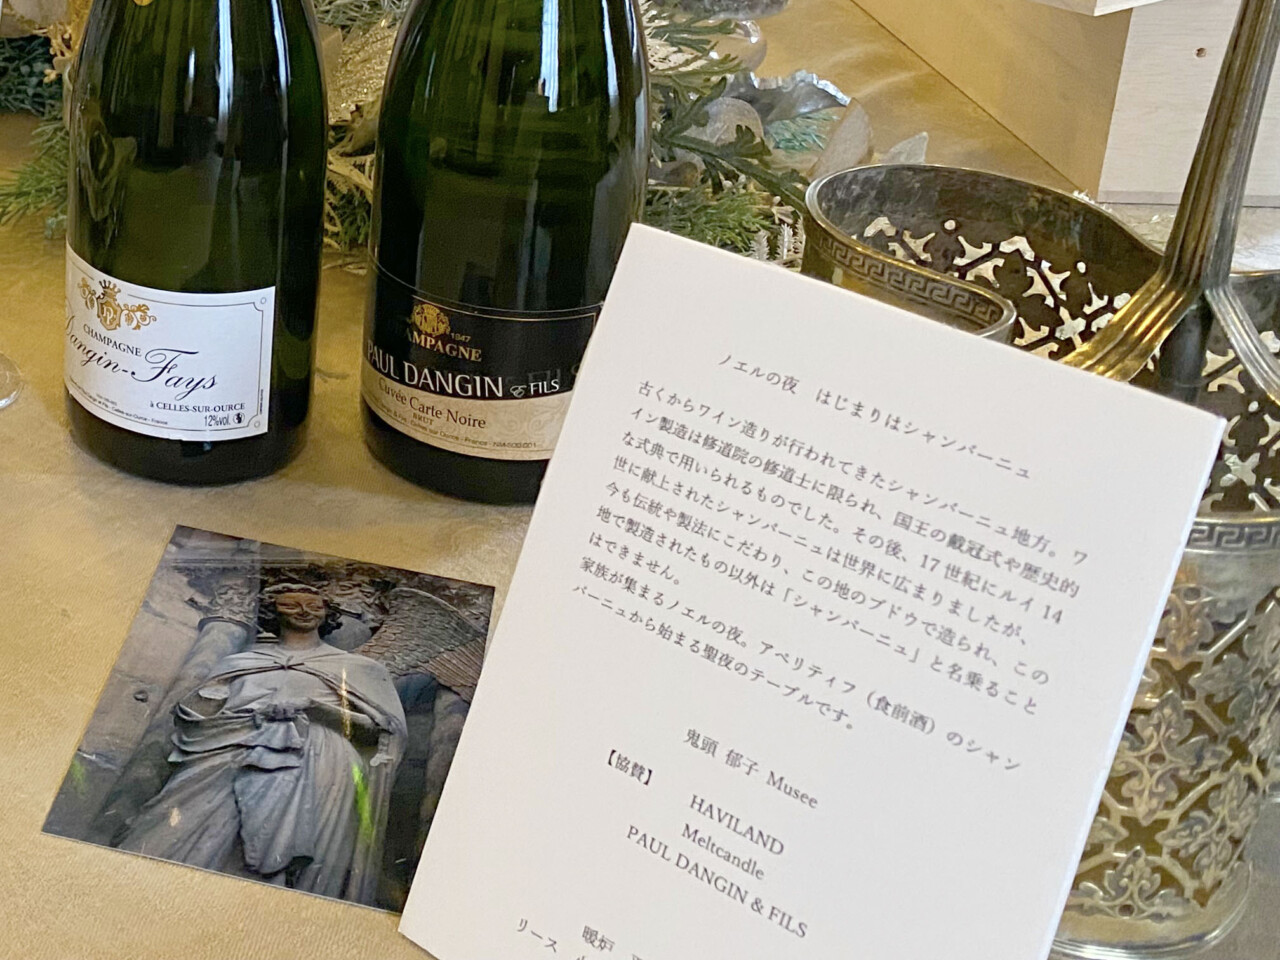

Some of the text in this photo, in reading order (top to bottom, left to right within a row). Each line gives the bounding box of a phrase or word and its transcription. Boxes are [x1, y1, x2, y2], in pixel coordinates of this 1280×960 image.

[83, 323, 142, 357] CHAMPAGNE
[368, 340, 400, 380] PAUL
[403, 360, 503, 398] DANGIN
[530, 379, 560, 395] FILS
[156, 402, 246, 413] CELLES-SUR-OURCE
[378, 378, 407, 405] Cuvée
[410, 396, 443, 419] Carte
[446, 409, 487, 429] Noire
[719, 355, 1029, 479] ノエルの夜 はじまりはシャンパーニュ
[589, 532, 679, 585] はできません。
[608, 749, 653, 786] 【協賛】
[683, 729, 818, 808] 鬼頭 郁子 Musee
[689, 794, 784, 855] HAVILAND
[681, 823, 764, 880] Meltcandle
[627, 825, 807, 938] PAUL DANGIN & FILS
[517, 918, 557, 952] リース
[582, 925, 616, 952] 暖炉
